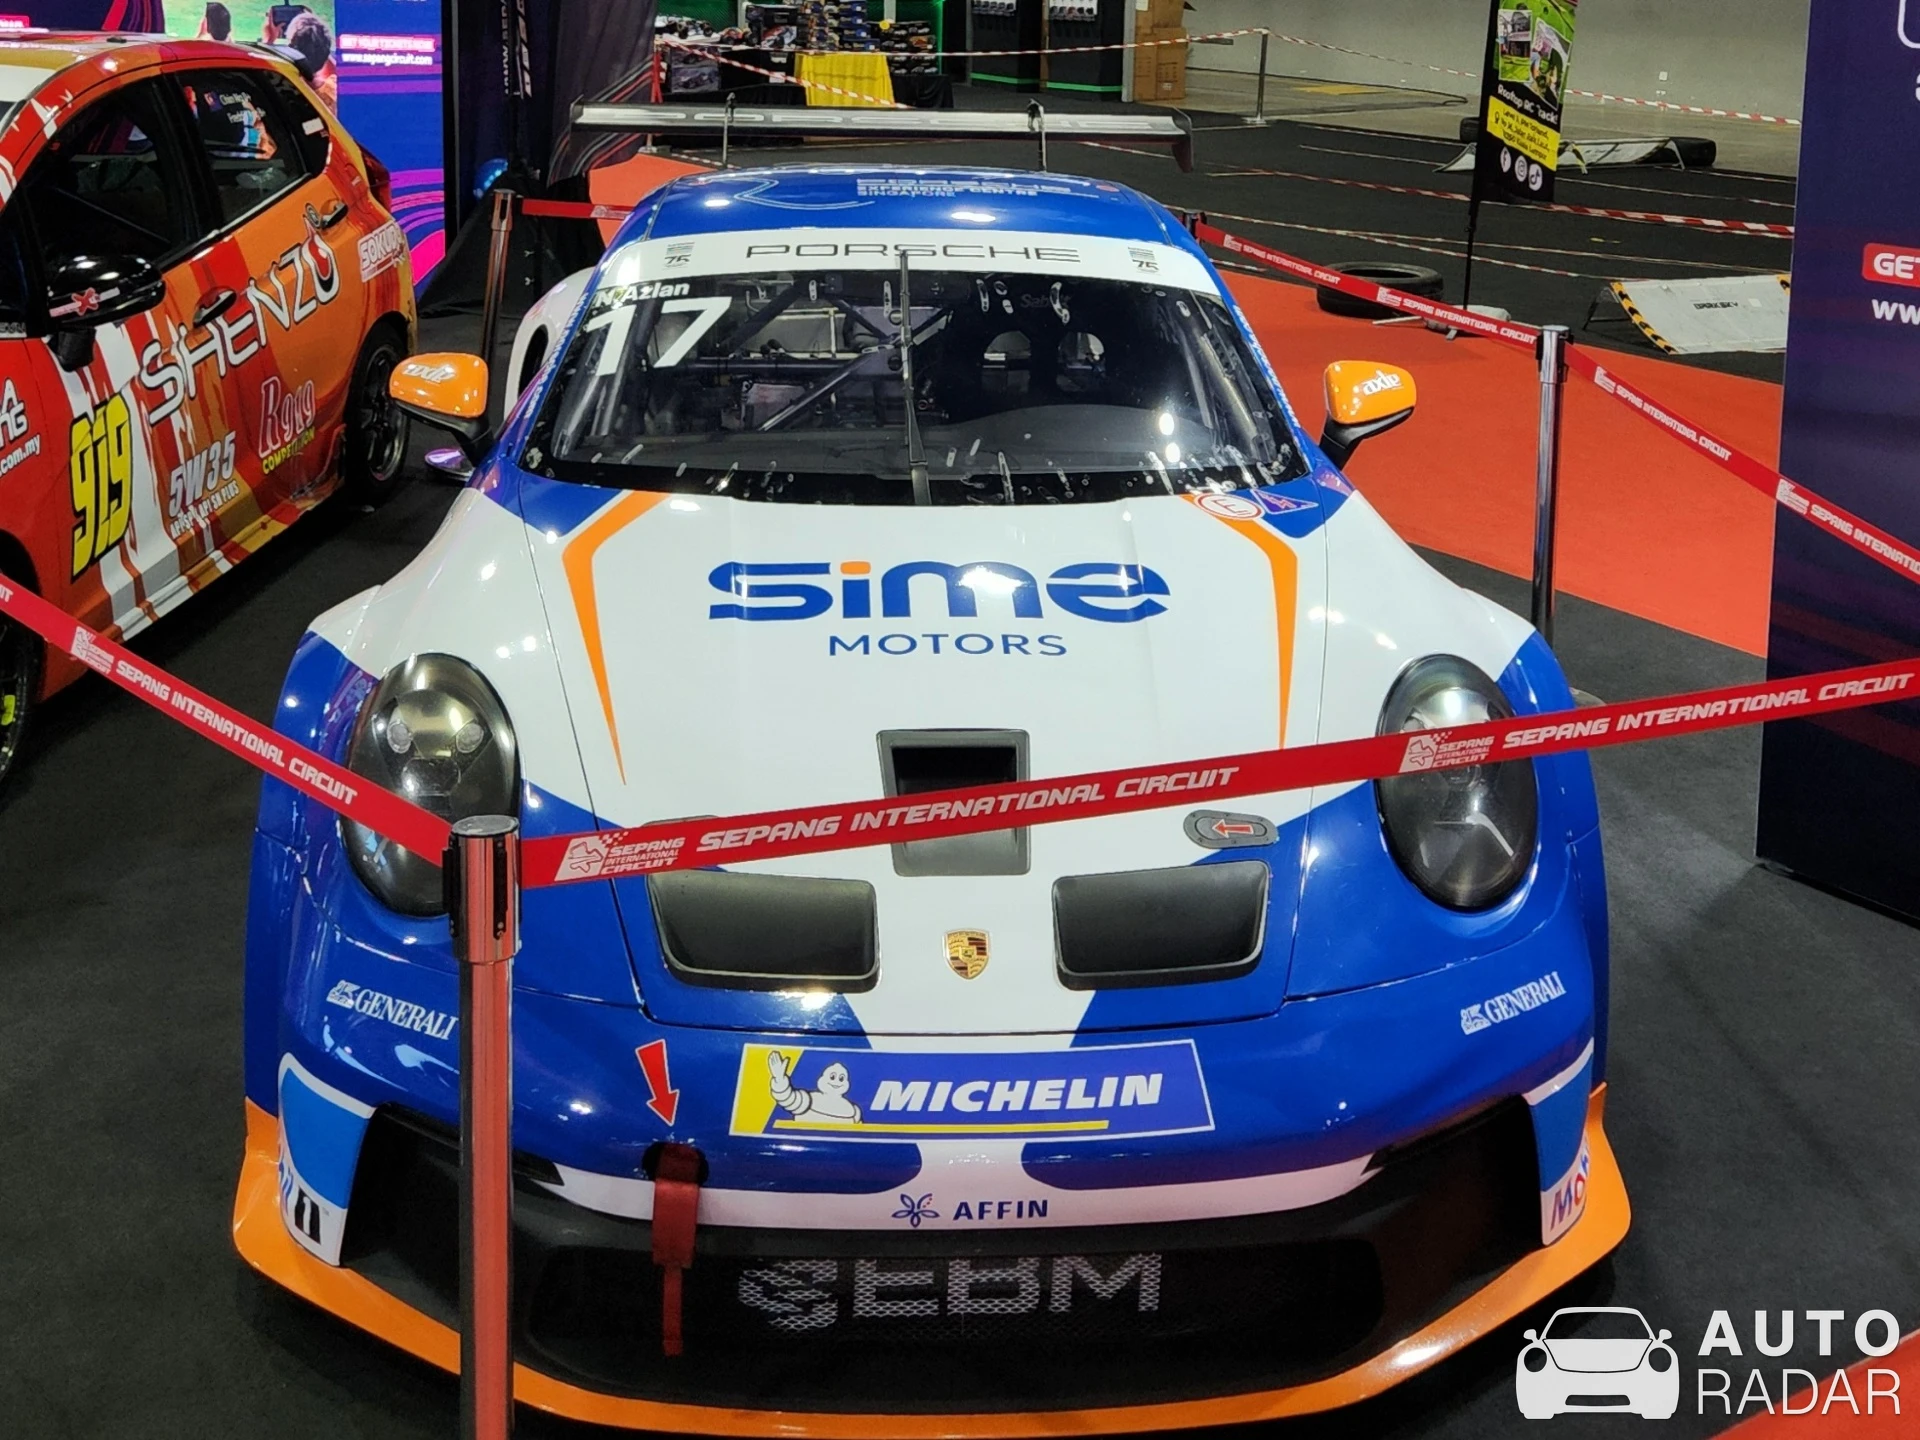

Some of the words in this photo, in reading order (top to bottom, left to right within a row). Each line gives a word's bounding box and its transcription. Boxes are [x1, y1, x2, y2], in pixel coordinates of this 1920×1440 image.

[857, 190, 956, 198] SINGAPORE
[746, 243, 1081, 263] PORSCHE
[586, 296, 733, 377] 17
[1403, 298, 1434, 315] SEPANG
[1435, 308, 1499, 334] INTERNATIONAL
[1500, 327, 1537, 344] CIRCUIT
[71, 393, 132, 577] 919
[169, 430, 237, 518] 5W35
[1810, 503, 1854, 536] SEPANG
[829, 633, 1067, 657] MOTORS
[1502, 717, 1611, 749] SEPANG
[1616, 690, 1811, 732] INTERNATIONAL
[1819, 673, 1915, 702] CIRCUIT
[116, 659, 171, 702] SEPANG
[171, 690, 285, 768] INTERNATIONAL
[288, 757, 358, 805] CIRCUIT
[1437, 736, 1496, 753] SEPANG
[1431, 753, 1489, 768] CIRCUIT
[1434, 746, 1490, 761] INTERNATIONAL
[696, 815, 843, 853] SEPANG
[849, 784, 1105, 832] INTERNATIONAL
[1115, 766, 1240, 799] CIRCUIT
[604, 849, 680, 866] INTERNATIONAL
[608, 837, 686, 858] SEPANG
[601, 857, 679, 875] CIRCUIT
[1484, 971, 1567, 1023] GENERALI
[355, 988, 459, 1040] GENERALI
[870, 1073, 1163, 1112] MICHELIN
[952, 1200, 1048, 1221] AFFIN
